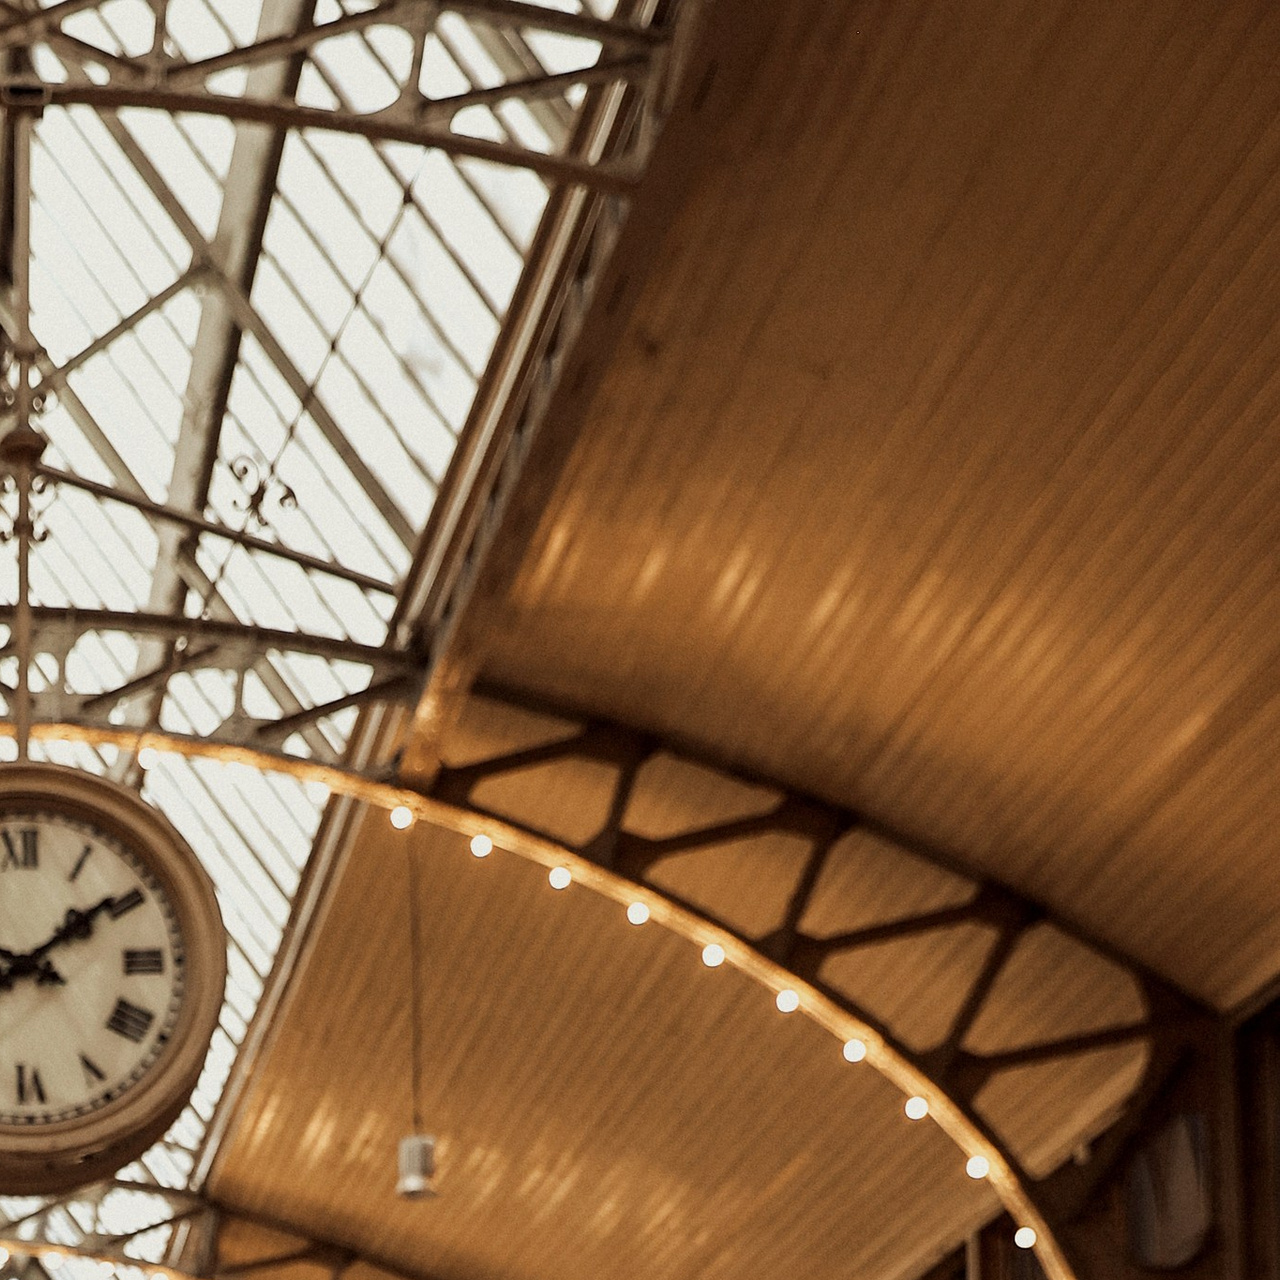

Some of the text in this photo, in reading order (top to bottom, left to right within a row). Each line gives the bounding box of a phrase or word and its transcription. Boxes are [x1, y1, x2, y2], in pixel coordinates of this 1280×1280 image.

[0, 828, 39, 871] XII
[69, 844, 92, 884] I
[123, 949, 164, 976] III
[16, 1062, 47, 1105] VI
[78, 1052, 107, 1089] V
